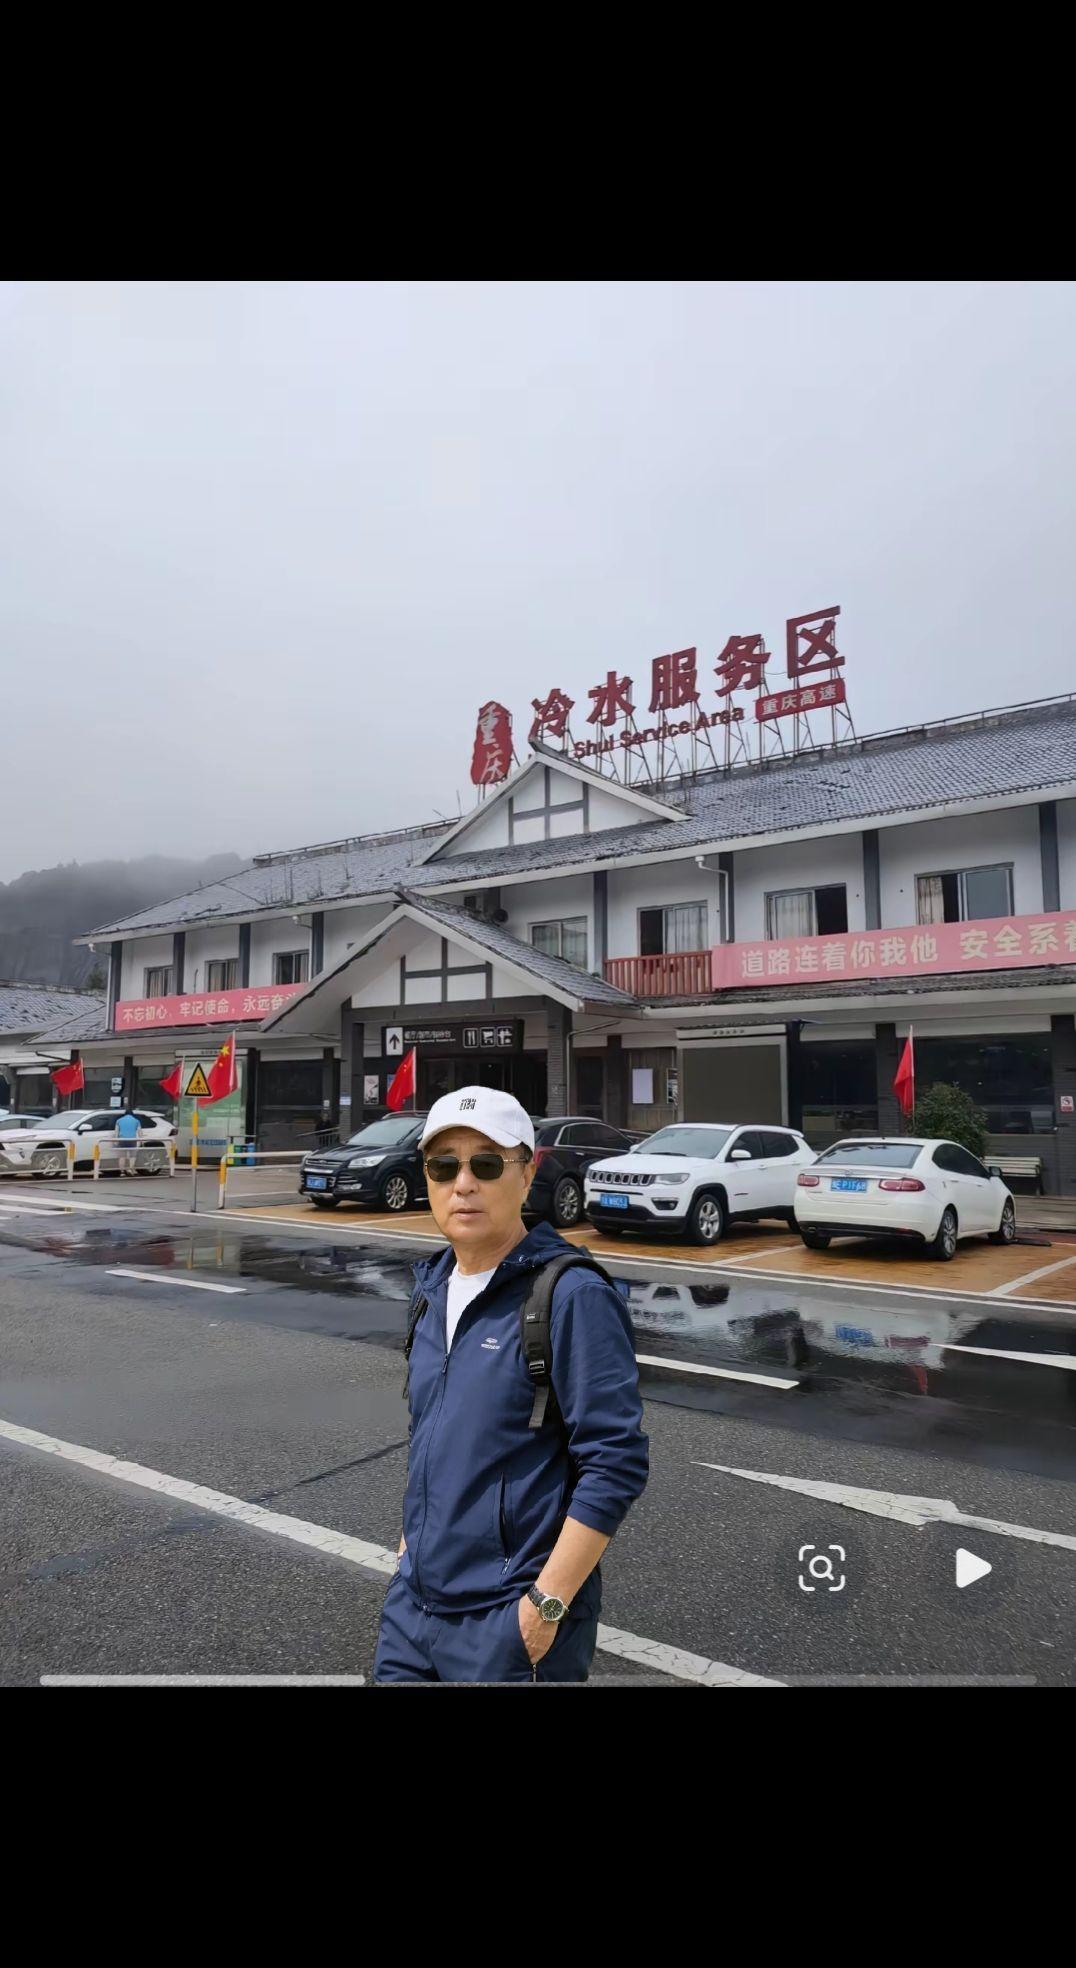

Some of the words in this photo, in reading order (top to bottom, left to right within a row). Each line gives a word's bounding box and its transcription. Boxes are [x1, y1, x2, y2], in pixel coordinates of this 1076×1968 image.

[528, 605, 846, 739] 冷水服务区
[761, 683, 837, 713] 重庆高速
[477, 701, 506, 784] 重庆
[619, 719, 694, 749] Service
[694, 705, 745, 731] Area
[740, 934, 939, 979] 道路连着你我他
